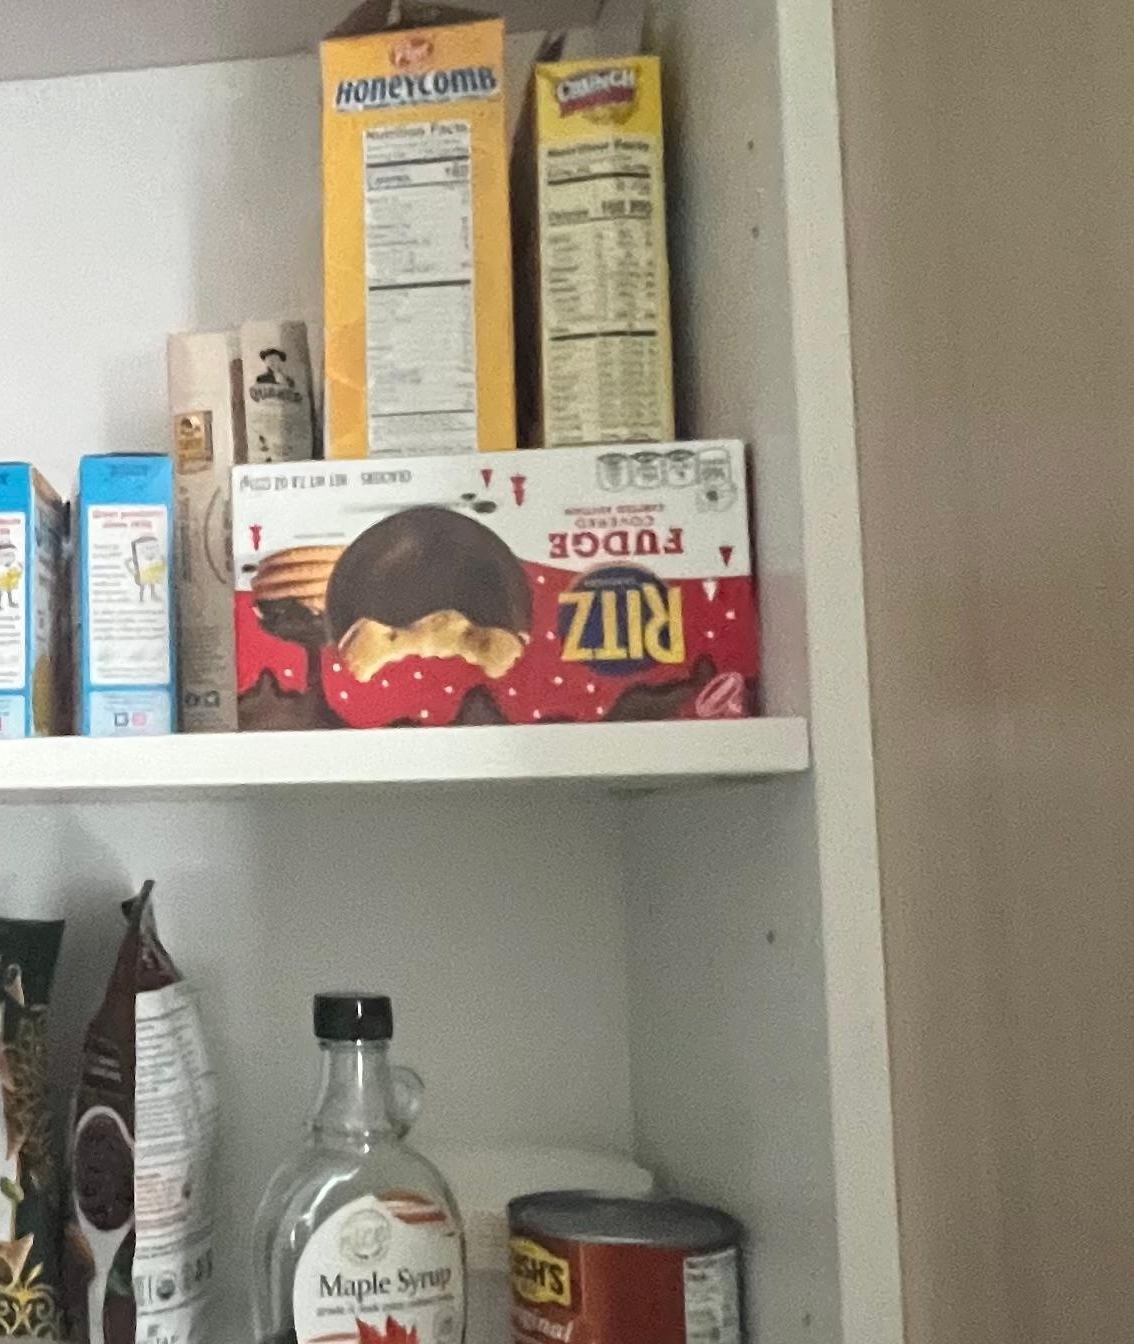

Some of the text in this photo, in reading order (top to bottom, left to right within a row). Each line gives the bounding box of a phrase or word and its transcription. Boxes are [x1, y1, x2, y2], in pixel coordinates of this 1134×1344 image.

[336, 66, 497, 105] HONEYCOMB
[574, 515, 655, 529] COVERED
[548, 528, 684, 559] FUDGE
[558, 583, 686, 664] RITZ
[319, 1267, 452, 1303] Maple Syrup
